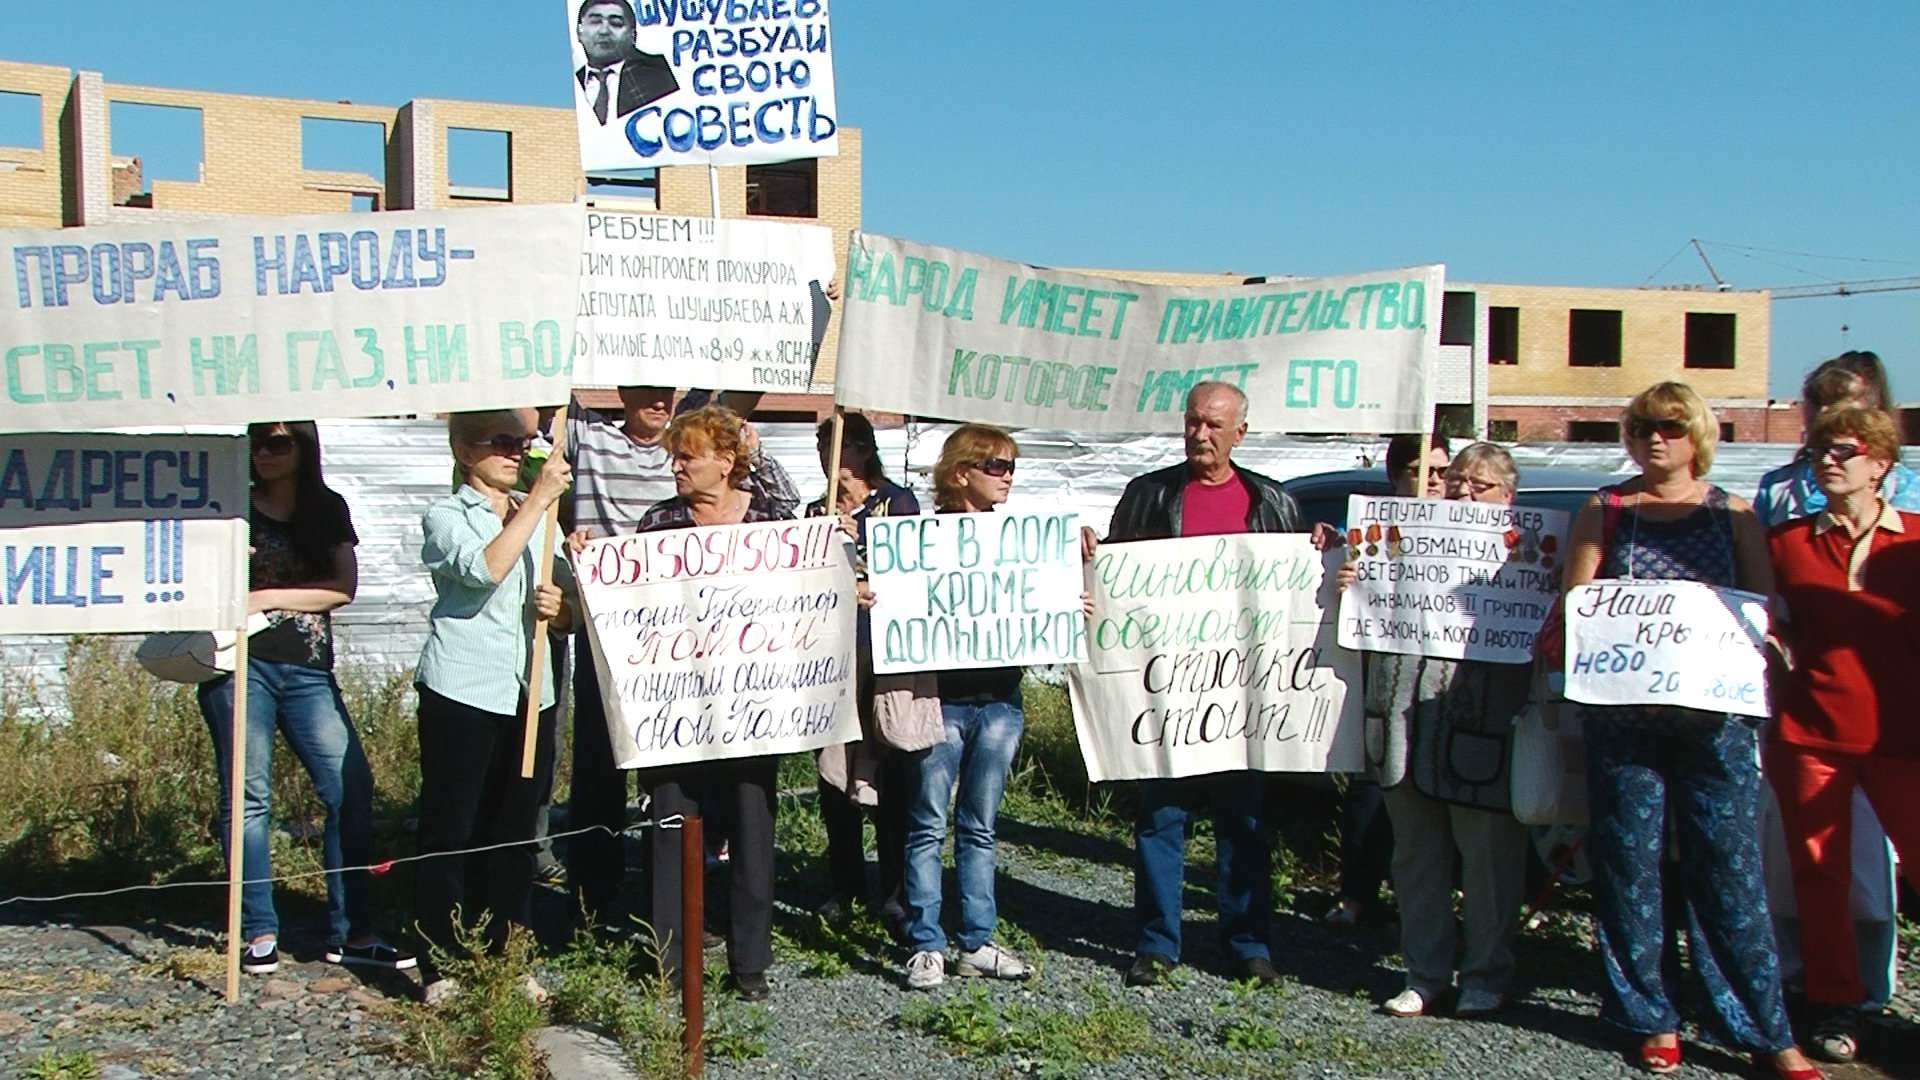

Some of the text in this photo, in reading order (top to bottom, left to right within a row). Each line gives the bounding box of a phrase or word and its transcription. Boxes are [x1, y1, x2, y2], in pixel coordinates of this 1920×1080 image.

[672, 23, 828, 68] РАЗБУДИ
[692, 59, 812, 97] СВОЮ
[624, 94, 837, 159] СОВЕСТЬ
[13, 226, 476, 309] ПРОРАБ НАРОДУ-
[620, 254, 710, 283] КОНТРОЛЕМ
[716, 259, 798, 286] ПРОКУРОРА
[576, 291, 657, 318] ДЕПУТАТА
[667, 294, 774, 323] ШУШУБАЕВА
[845, 244, 979, 322] НАРОД
[1000, 275, 1140, 341] ИМЕЕТ
[5, 338, 177, 404] СВЕТ,
[189, 332, 260, 396] НИ
[403, 322, 470, 386] НИ
[595, 331, 649, 358] ЖИЛЫЕ
[651, 333, 695, 361] ДОМА
[948, 347, 1118, 413] КОТОРОЕ
[0, 448, 222, 513] АДРЕСУ,
[1361, 501, 1544, 531] ДЕПУТАТ ШУШУБАЕВ
[872, 512, 1080, 575] ВСЕ В ДОЛЕ
[1398, 536, 1500, 561] ОБМАНУЛ
[0, 545, 125, 608] ИЦЕ
[1094, 537, 1318, 600] Чиновники
[1357, 560, 1450, 584] ВЕТЕРАНОВ
[927, 567, 1041, 617] КРОМЕ
[1367, 592, 1456, 614] ИНВАЛИДОВ
[1483, 598, 1547, 621] ГРУППЫ
[1576, 585, 1677, 618] Наша
[1096, 605, 1284, 651] обещают
[1346, 617, 1372, 639] ГДЕ
[1442, 624, 1480, 645] КОГО
[1572, 643, 1647, 676] небо
